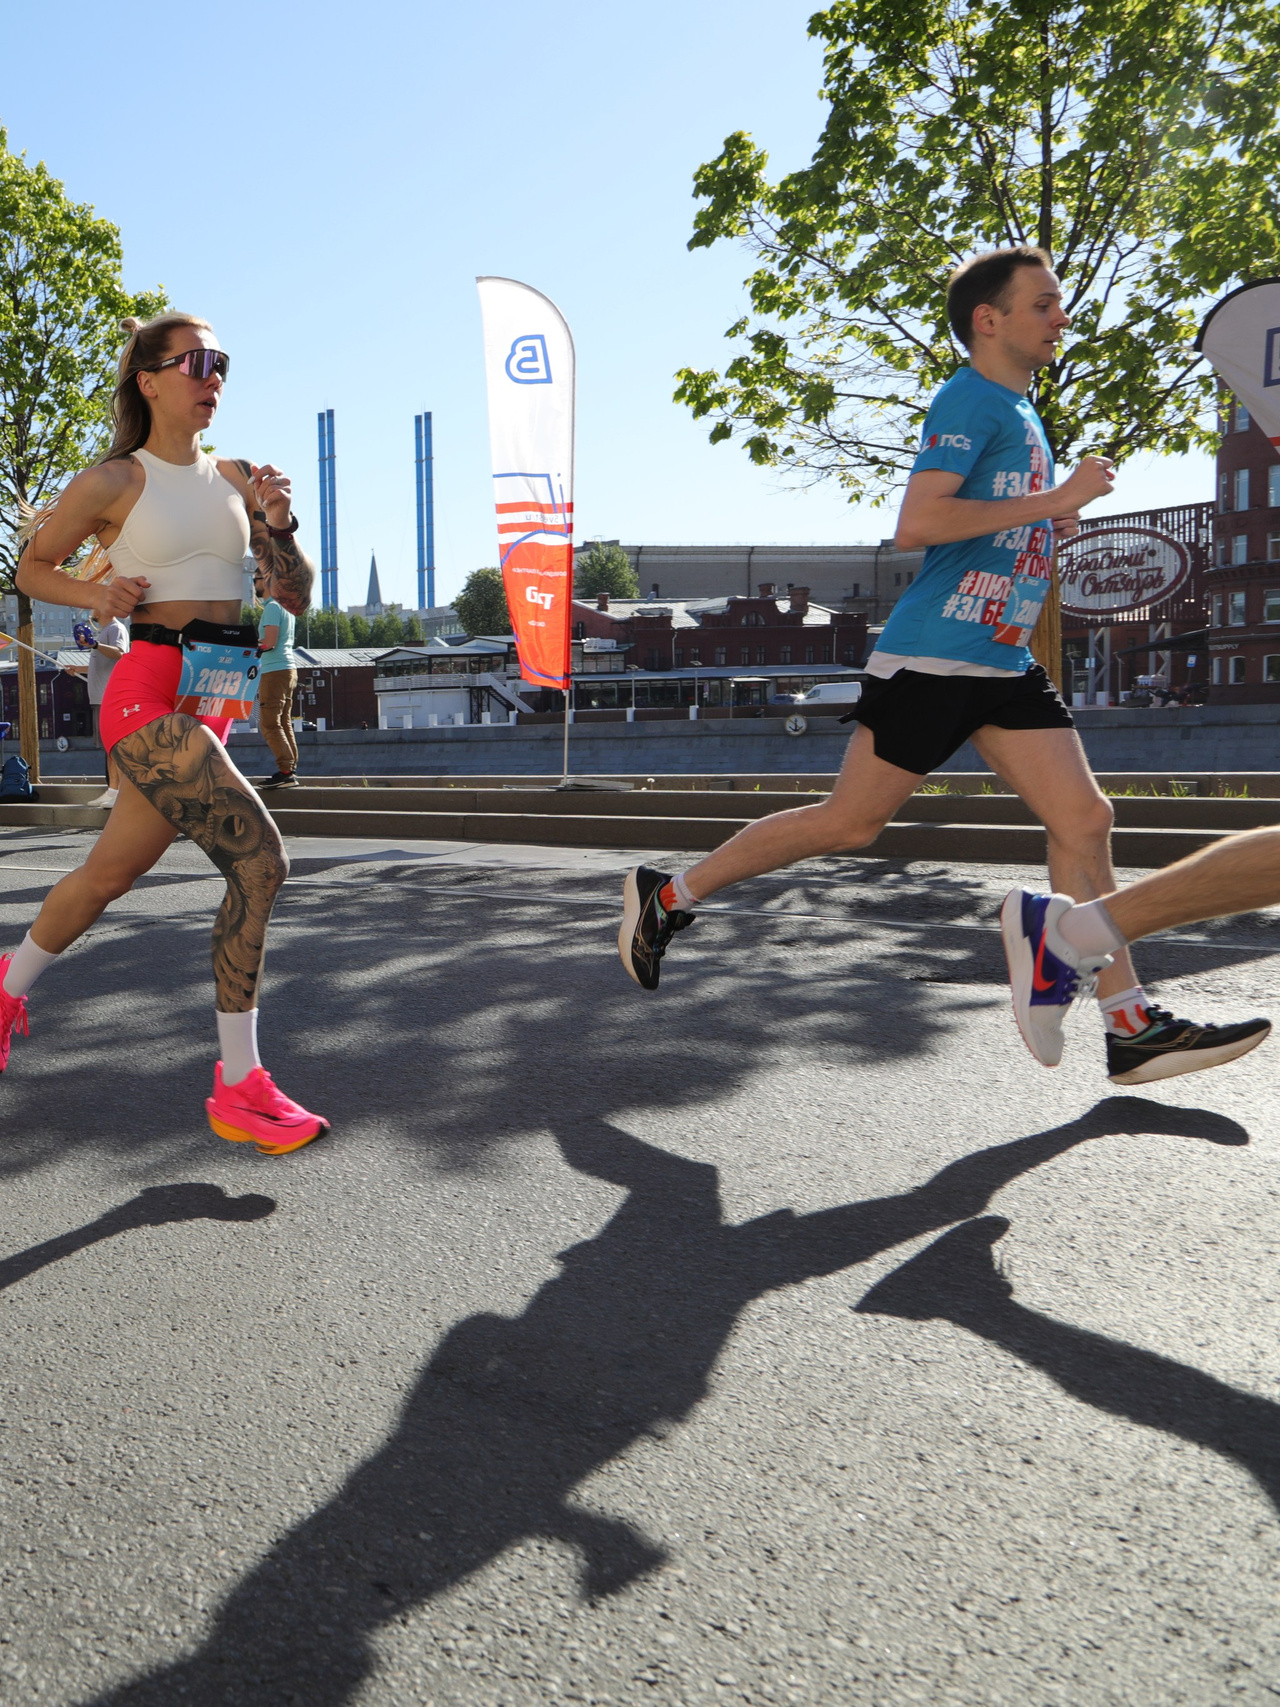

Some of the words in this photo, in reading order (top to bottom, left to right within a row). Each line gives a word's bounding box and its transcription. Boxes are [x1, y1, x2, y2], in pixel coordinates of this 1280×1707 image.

[939, 434, 972, 451] ПСБ
[1081, 567, 1166, 602] Октябрь
[194, 667, 243, 696] 21813
